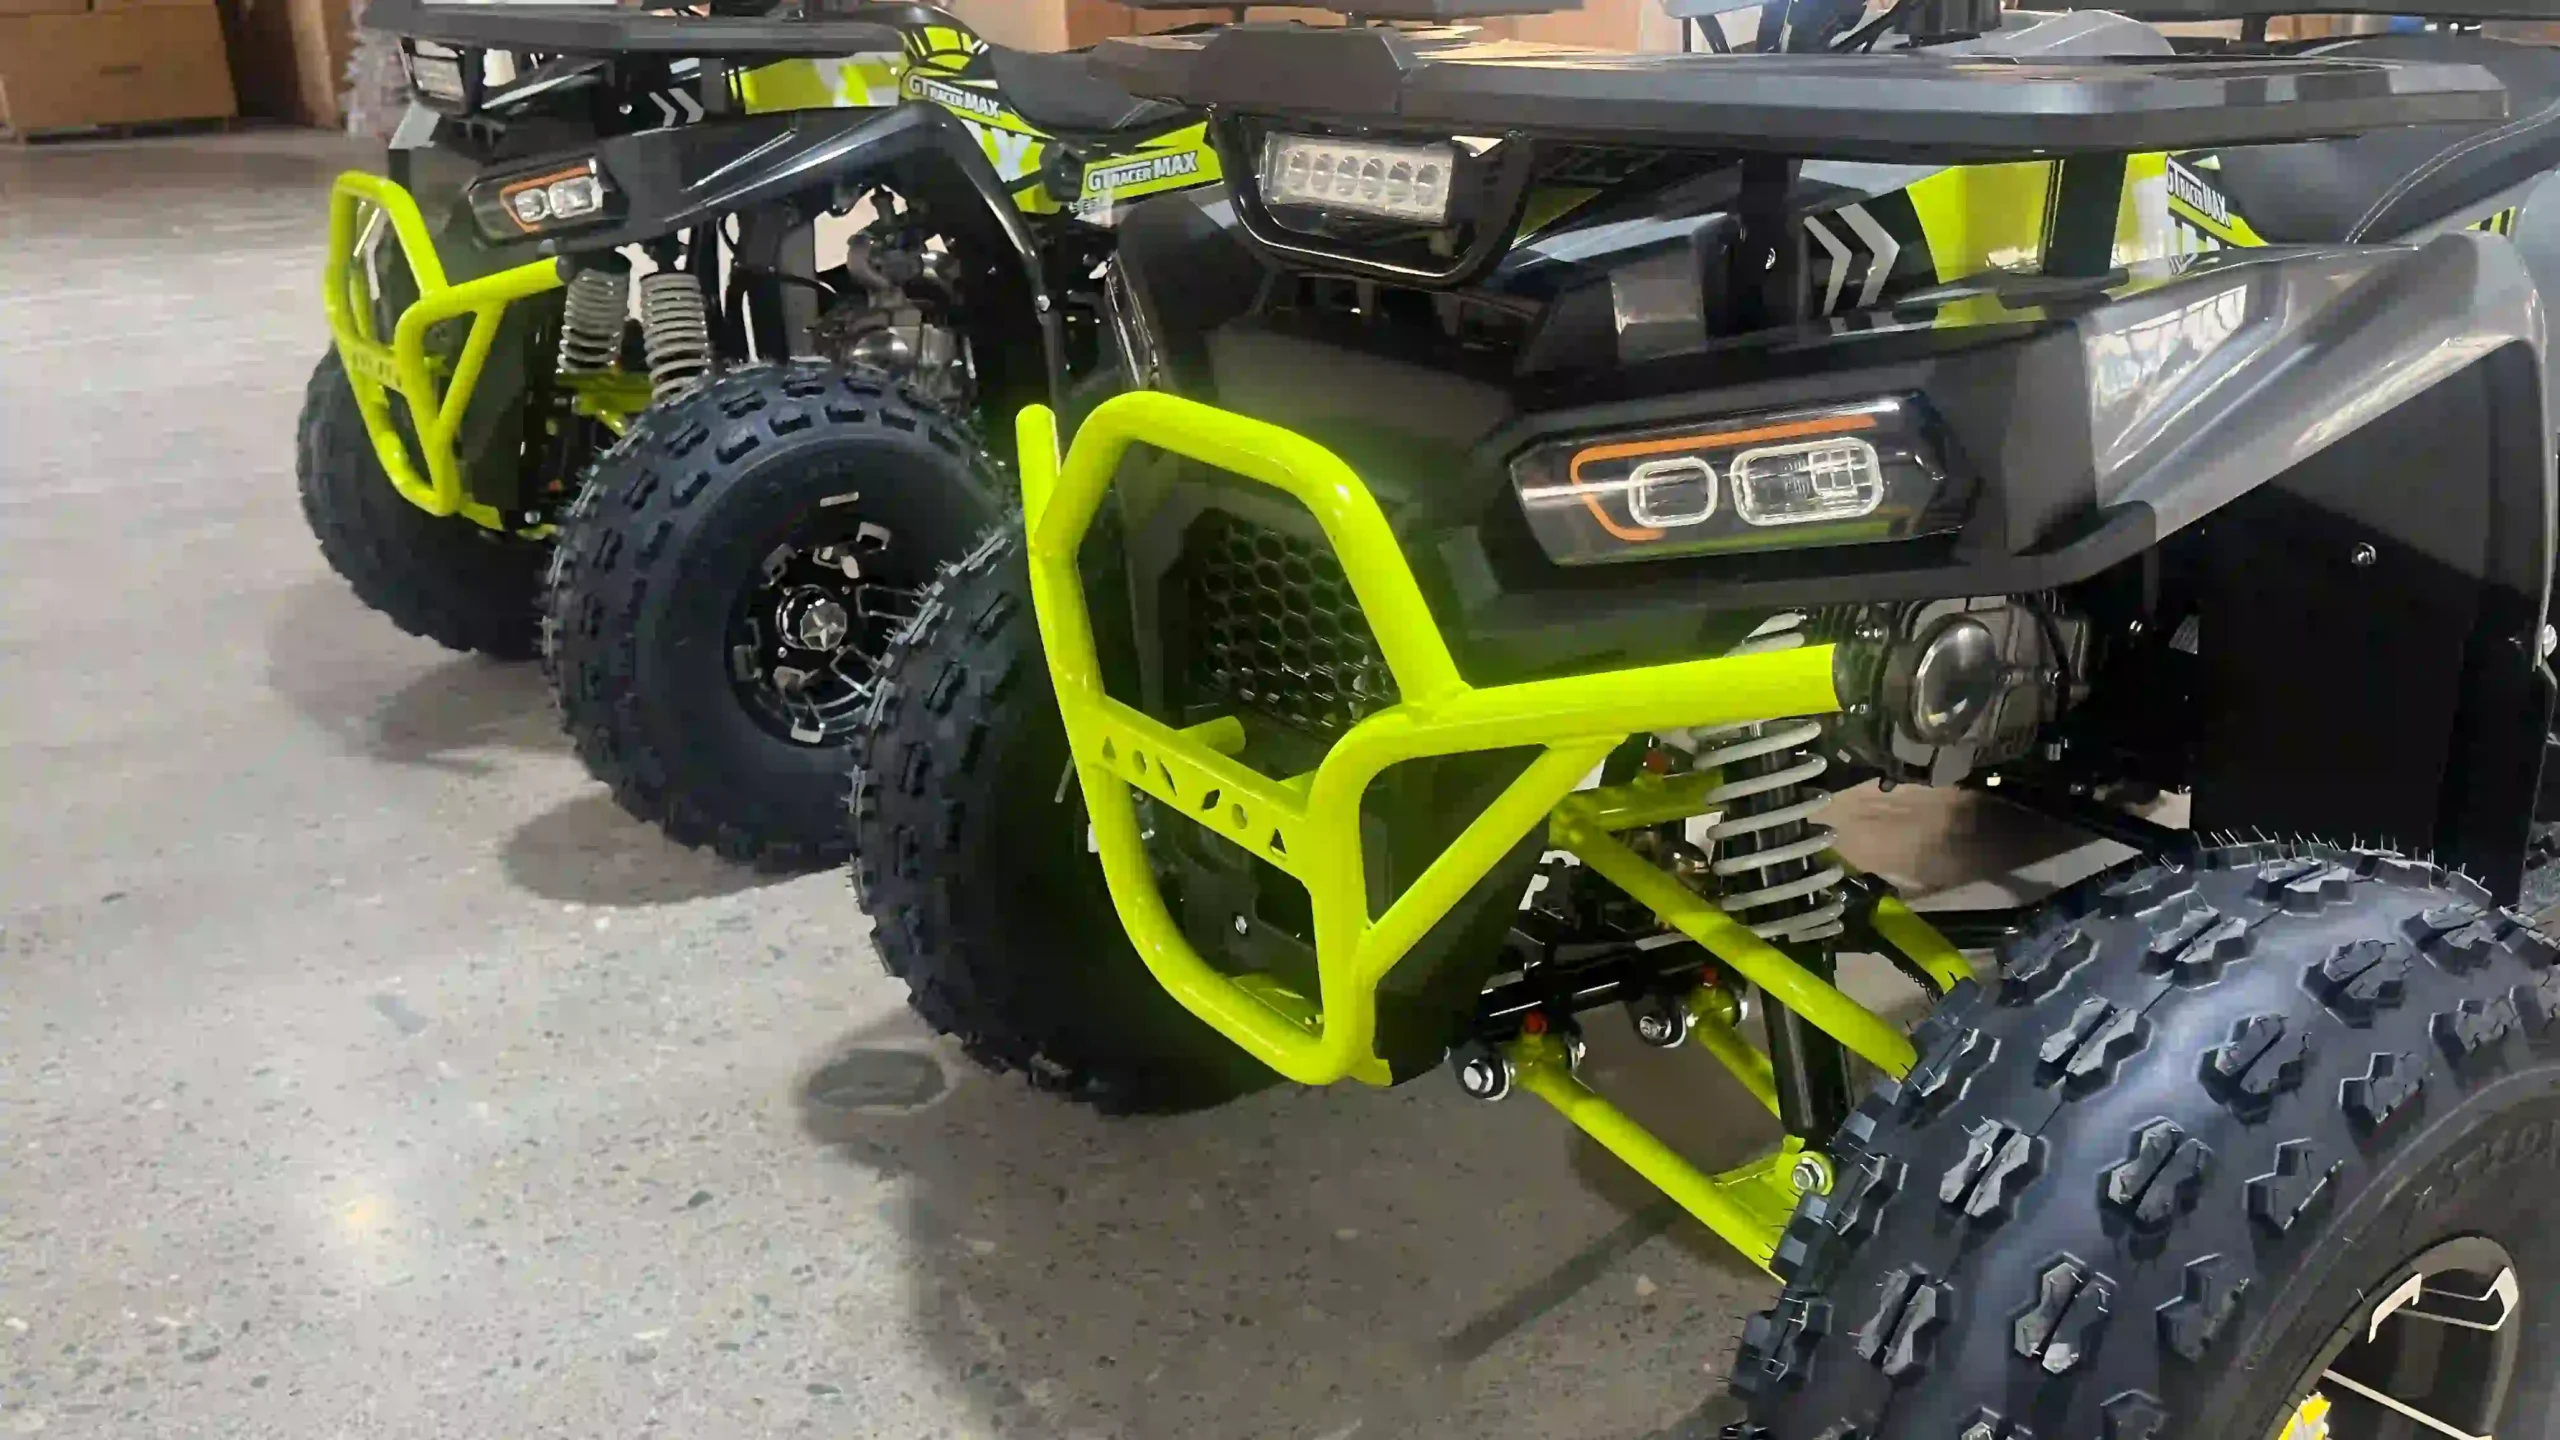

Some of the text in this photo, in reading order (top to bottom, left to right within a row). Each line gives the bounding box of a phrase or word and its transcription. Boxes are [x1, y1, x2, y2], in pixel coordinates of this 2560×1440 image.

[964, 91, 1000, 118] MAX
[1112, 166, 1152, 186] RACER
[1152, 151, 1198, 179] MAX
[2202, 182, 2232, 228] MAX
